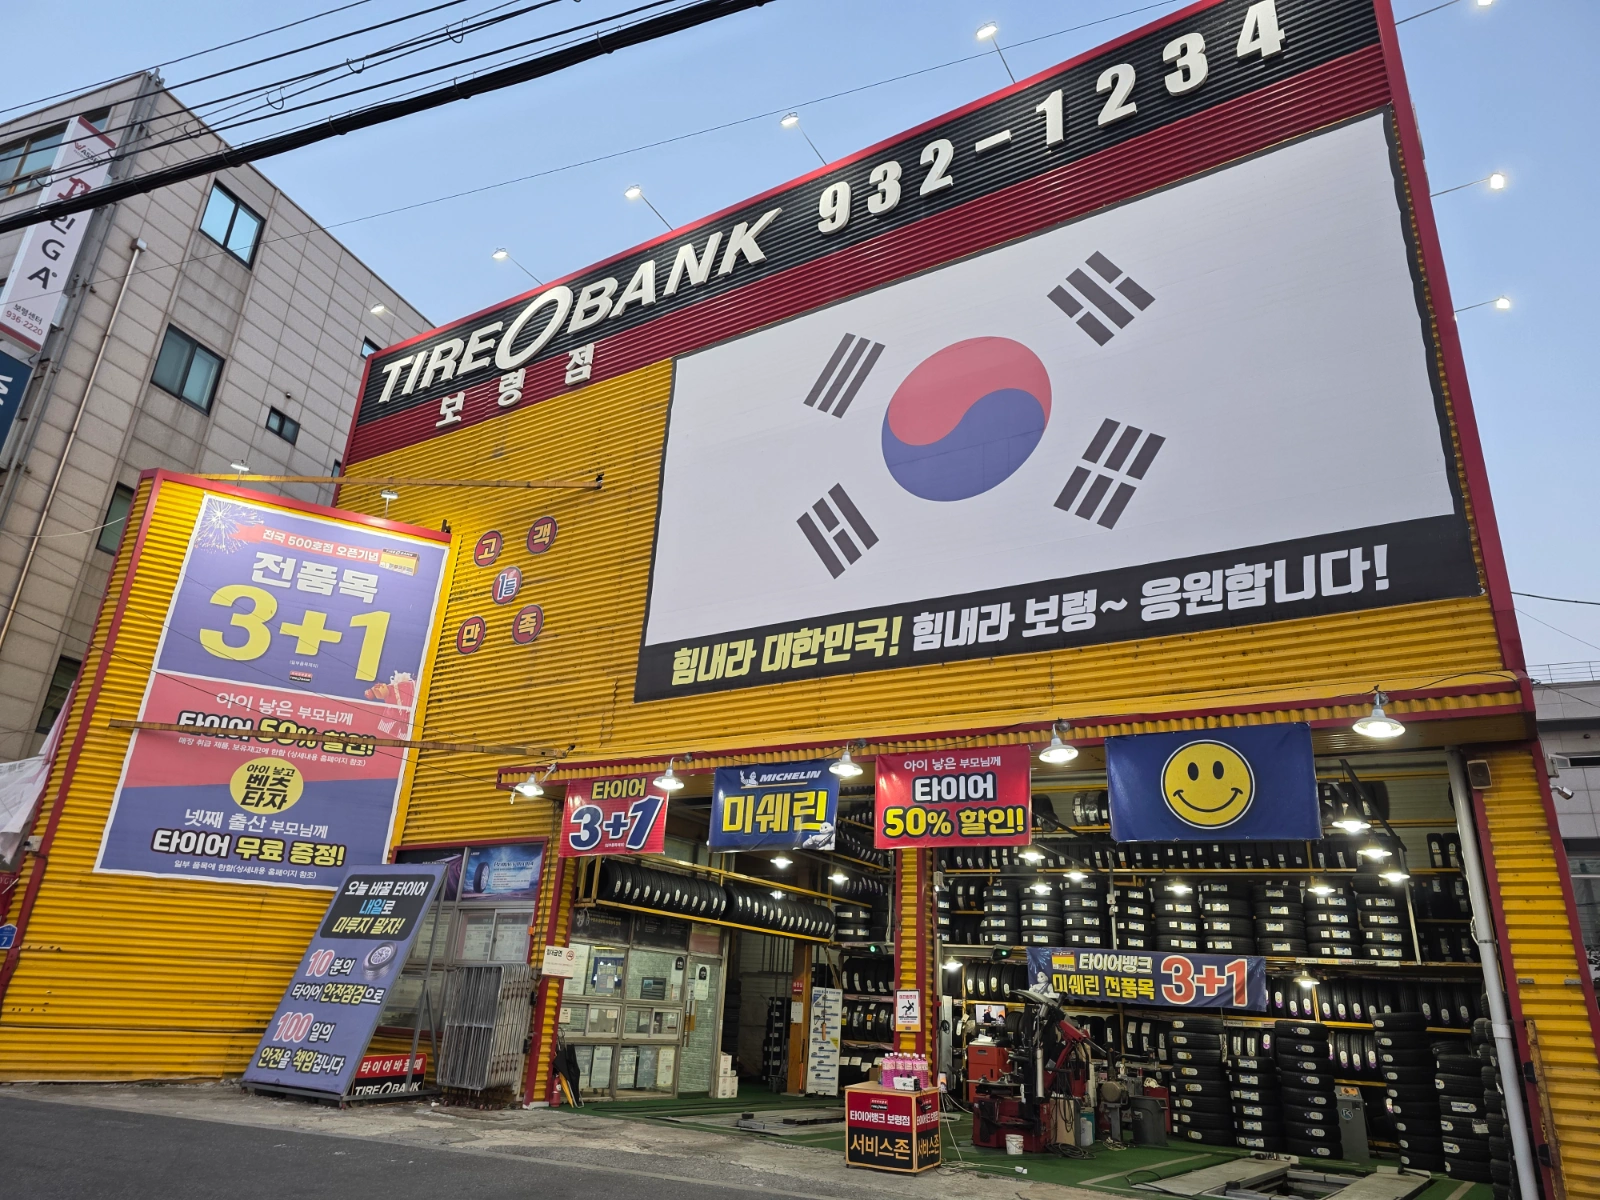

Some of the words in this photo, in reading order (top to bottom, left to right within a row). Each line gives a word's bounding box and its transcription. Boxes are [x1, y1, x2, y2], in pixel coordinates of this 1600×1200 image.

[12, 303, 43, 325] 보령센터
[435, 343, 595, 427] 보령점
[262, 529, 285, 543] 전국
[287, 534, 333, 554] 500호점
[335, 545, 379, 562] 오픈기념
[251, 551, 379, 604] 전품목
[671, 638, 757, 686] 힘내라
[760, 615, 903, 673] 대한민국!
[912, 601, 1015, 652] 힘내라
[1021, 588, 1128, 638] 보령~
[1140, 543, 1390, 622] 응원합니다!
[199, 584, 391, 682] 3+1
[216, 692, 253, 711] 아이
[259, 697, 293, 717] 낳은
[297, 706, 354, 726] 부모님께
[178, 711, 252, 740] 타이어
[257, 718, 317, 748] 50%
[178, 737, 194, 745] 매장
[196, 739, 212, 747] 취급
[232, 743, 269, 755] 보유재고에
[271, 748, 287, 757] 한함
[287, 750, 318, 761] (상세내용
[320, 754, 348, 764] 홈페이지
[349, 757, 366, 766] 참조)
[904, 759, 928, 772] 아이
[931, 757, 956, 771] 낳은
[959, 755, 1001, 769] 부모님께
[245, 774, 291, 793] 벤츠
[246, 764, 270, 774] 아이
[272, 766, 296, 777] 낳고
[759, 770, 822, 783] MICHELIN
[240, 790, 288, 810] 타자
[591, 777, 647, 801] 타이어
[914, 773, 994, 802] 타이어
[184, 808, 224, 829] 넷째
[228, 813, 267, 833] 출산
[269, 820, 329, 839] 부모님께
[569, 794, 664, 851] 3+1
[721, 789, 828, 834] 미쉐린
[885, 807, 952, 837] 50%
[959, 807, 1025, 836] 할인!
[153, 829, 231, 857] 타이어
[235, 837, 285, 862] 무료
[289, 841, 346, 867] 증정!
[174, 859, 190, 868] 일부
[192, 861, 216, 871] 품목에
[268, 867, 298, 878] 홈페이지
[299, 870, 317, 879] 참조)
[344, 880, 370, 896] 오늘
[368, 880, 395, 896] 바꿀
[392, 881, 428, 897] 타이어
[359, 898, 395, 915] 내일로
[331, 917, 371, 934] 미루지
[369, 917, 406, 935] 말자!
[291, 983, 321, 1001] 타이어
[320, 983, 385, 1004] 안전점검으로
[1051, 973, 1100, 996] 미쉐린
[1104, 975, 1155, 1000] 전품목
[1078, 952, 1153, 974] 타이어뱅크
[1161, 955, 1248, 1007] 3+1
[257, 1047, 291, 1068] 안전을
[292, 1048, 346, 1075] 책임집니다
[849, 1109, 886, 1124] 타이어뱅크
[887, 1114, 911, 1127] 보령점
[850, 1133, 911, 1160] 서비스존
